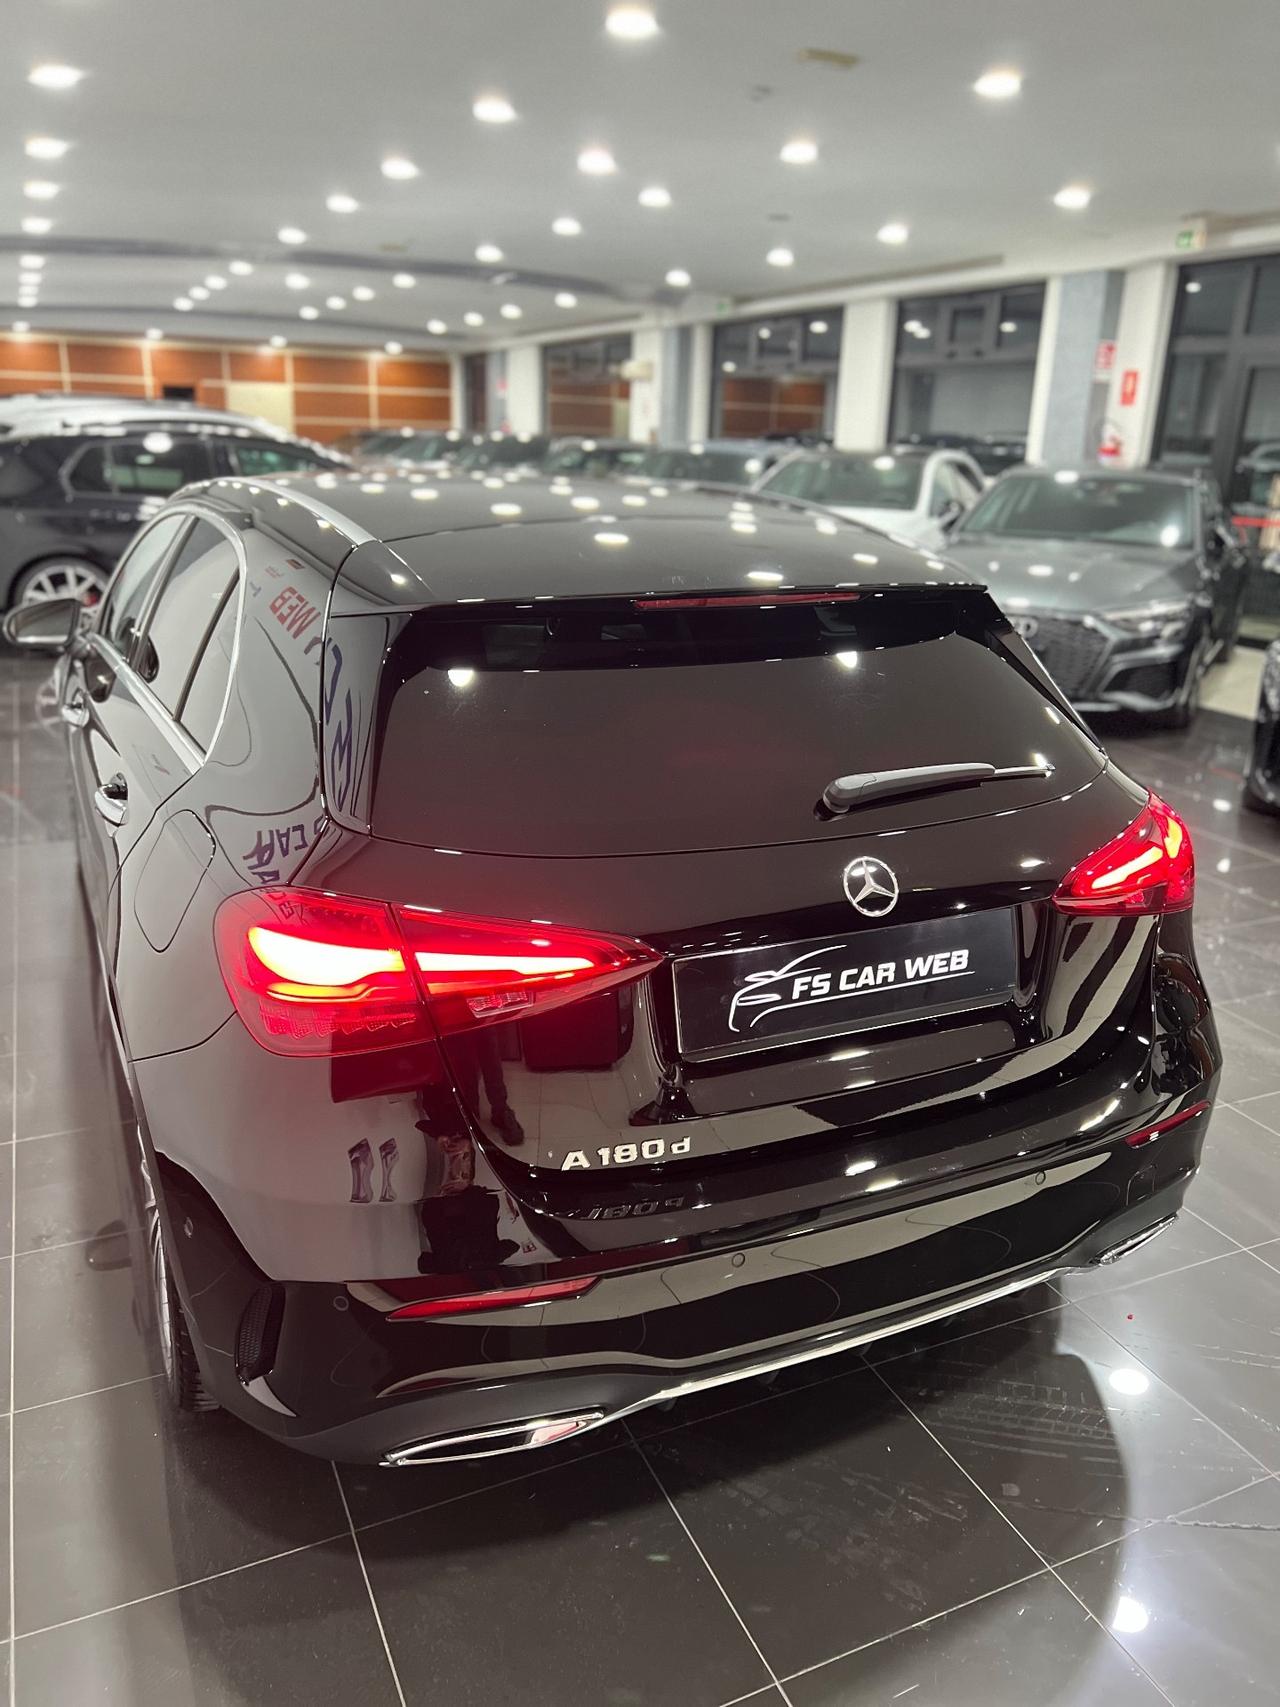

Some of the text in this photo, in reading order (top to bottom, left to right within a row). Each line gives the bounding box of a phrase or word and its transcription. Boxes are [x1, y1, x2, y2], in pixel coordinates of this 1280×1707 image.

[792, 949, 969, 1000] FS CAR WEB
[561, 1150, 591, 1171] A
[597, 1138, 666, 1166] 180
